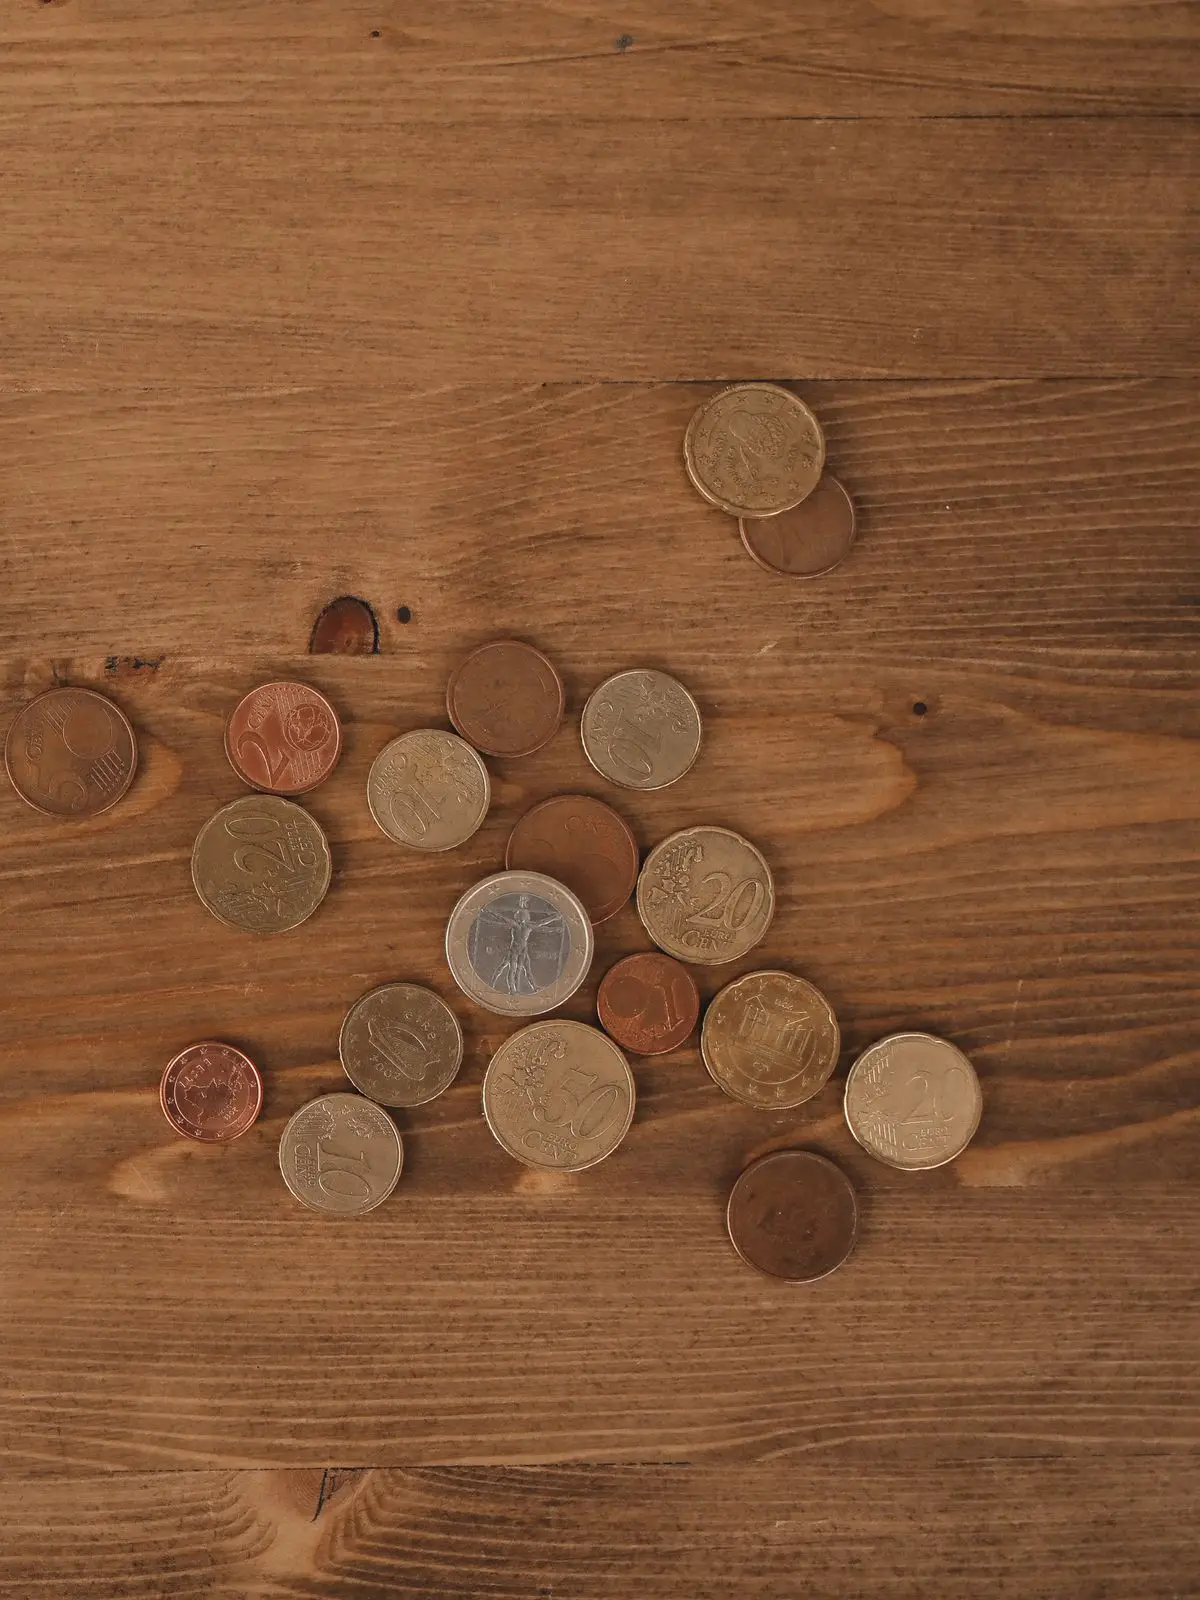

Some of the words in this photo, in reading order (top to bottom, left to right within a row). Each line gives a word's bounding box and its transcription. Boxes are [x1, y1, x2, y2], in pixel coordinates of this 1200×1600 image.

[237, 731, 291, 788] 2
[224, 809, 297, 875] 20
[685, 872, 765, 931] 20
[532, 1067, 627, 1141] 50
[316, 1141, 373, 1204] 10
